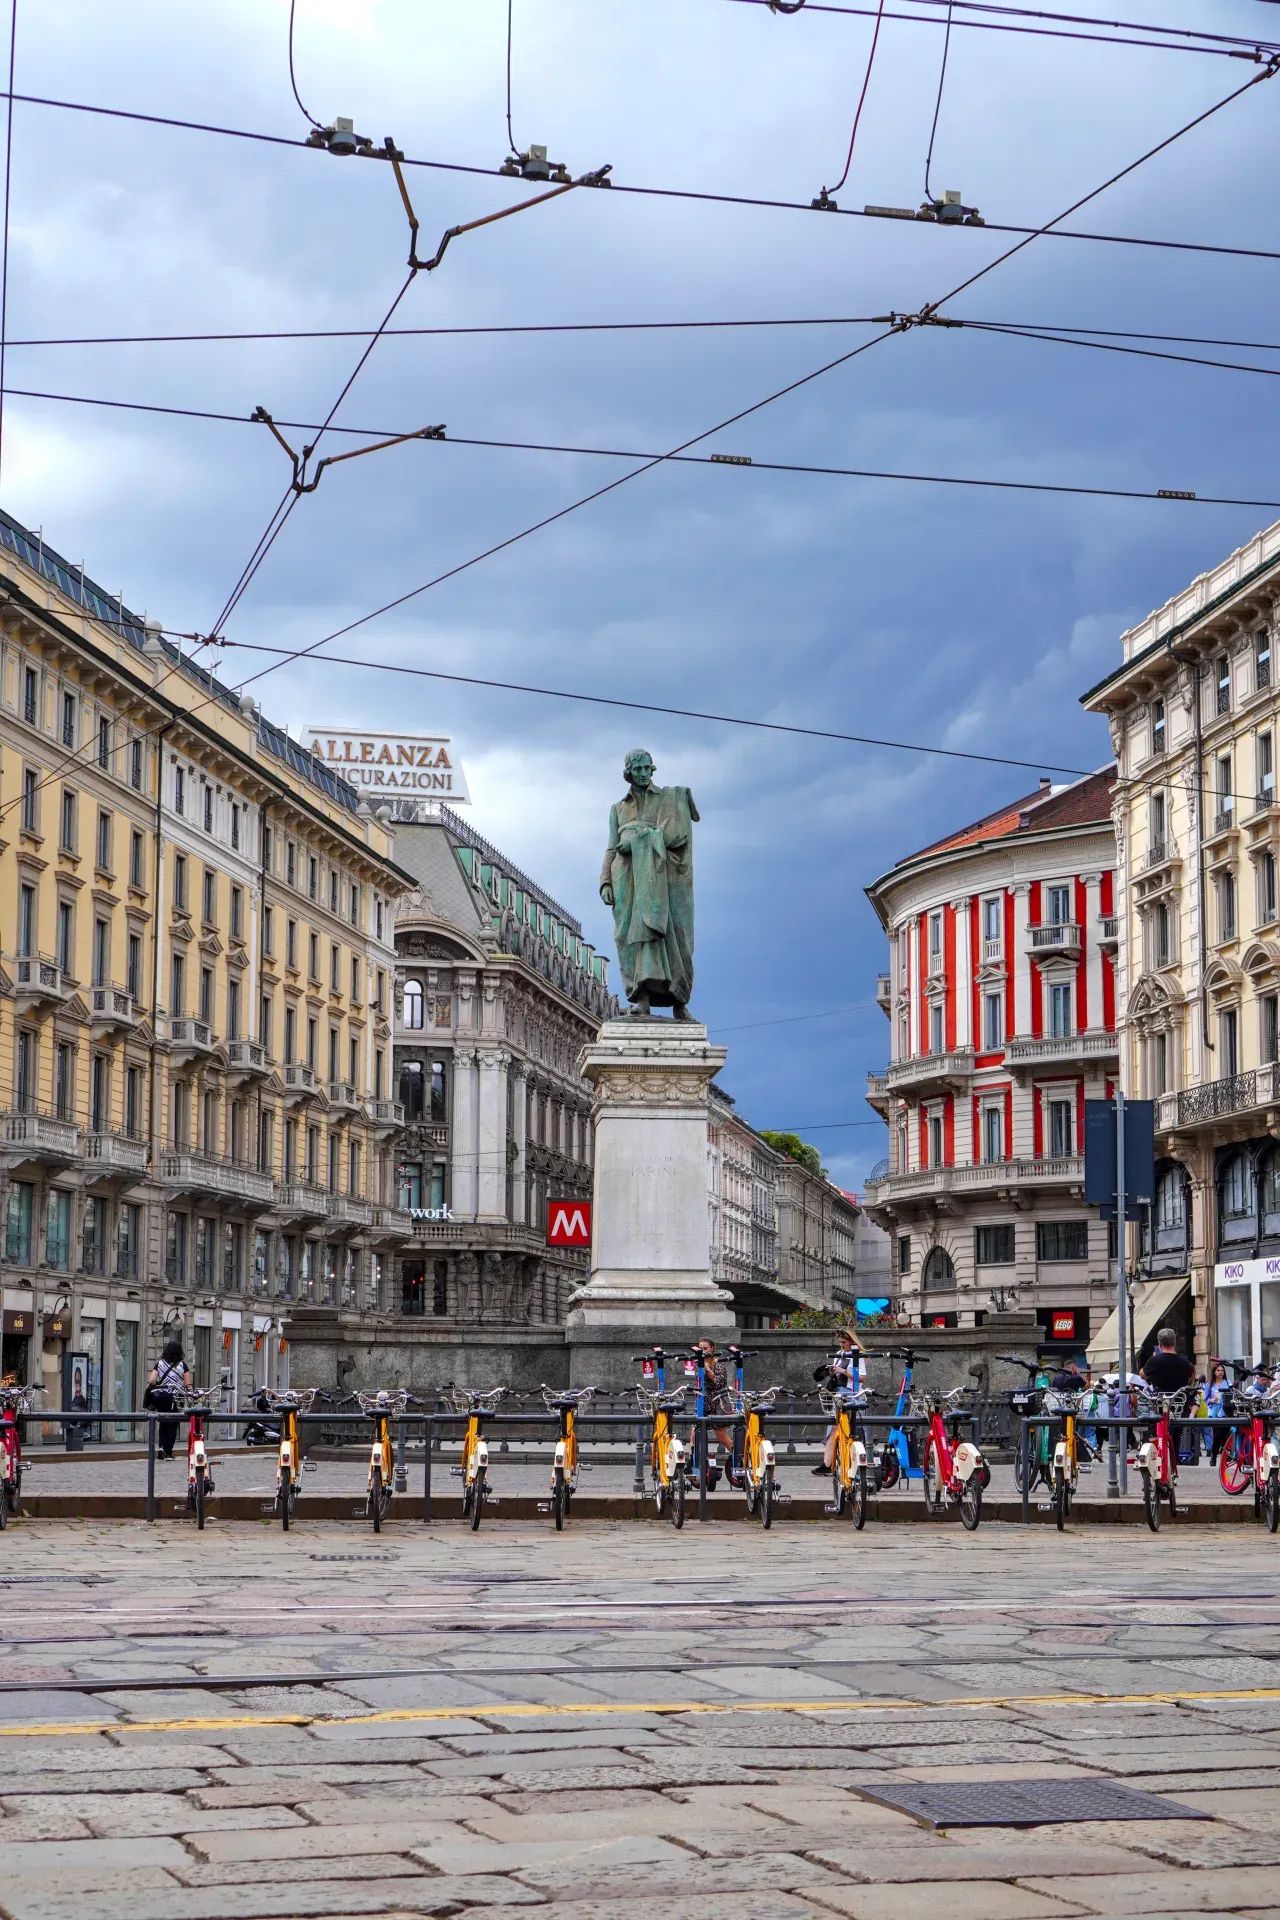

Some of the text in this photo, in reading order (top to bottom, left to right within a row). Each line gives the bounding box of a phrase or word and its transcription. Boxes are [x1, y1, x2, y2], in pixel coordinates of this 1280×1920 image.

[311, 738, 452, 768] ALLEANZA
[550, 1209, 588, 1237] M
[1224, 1263, 1244, 1279] KIKO
[1054, 1319, 1073, 1331] LEGO
